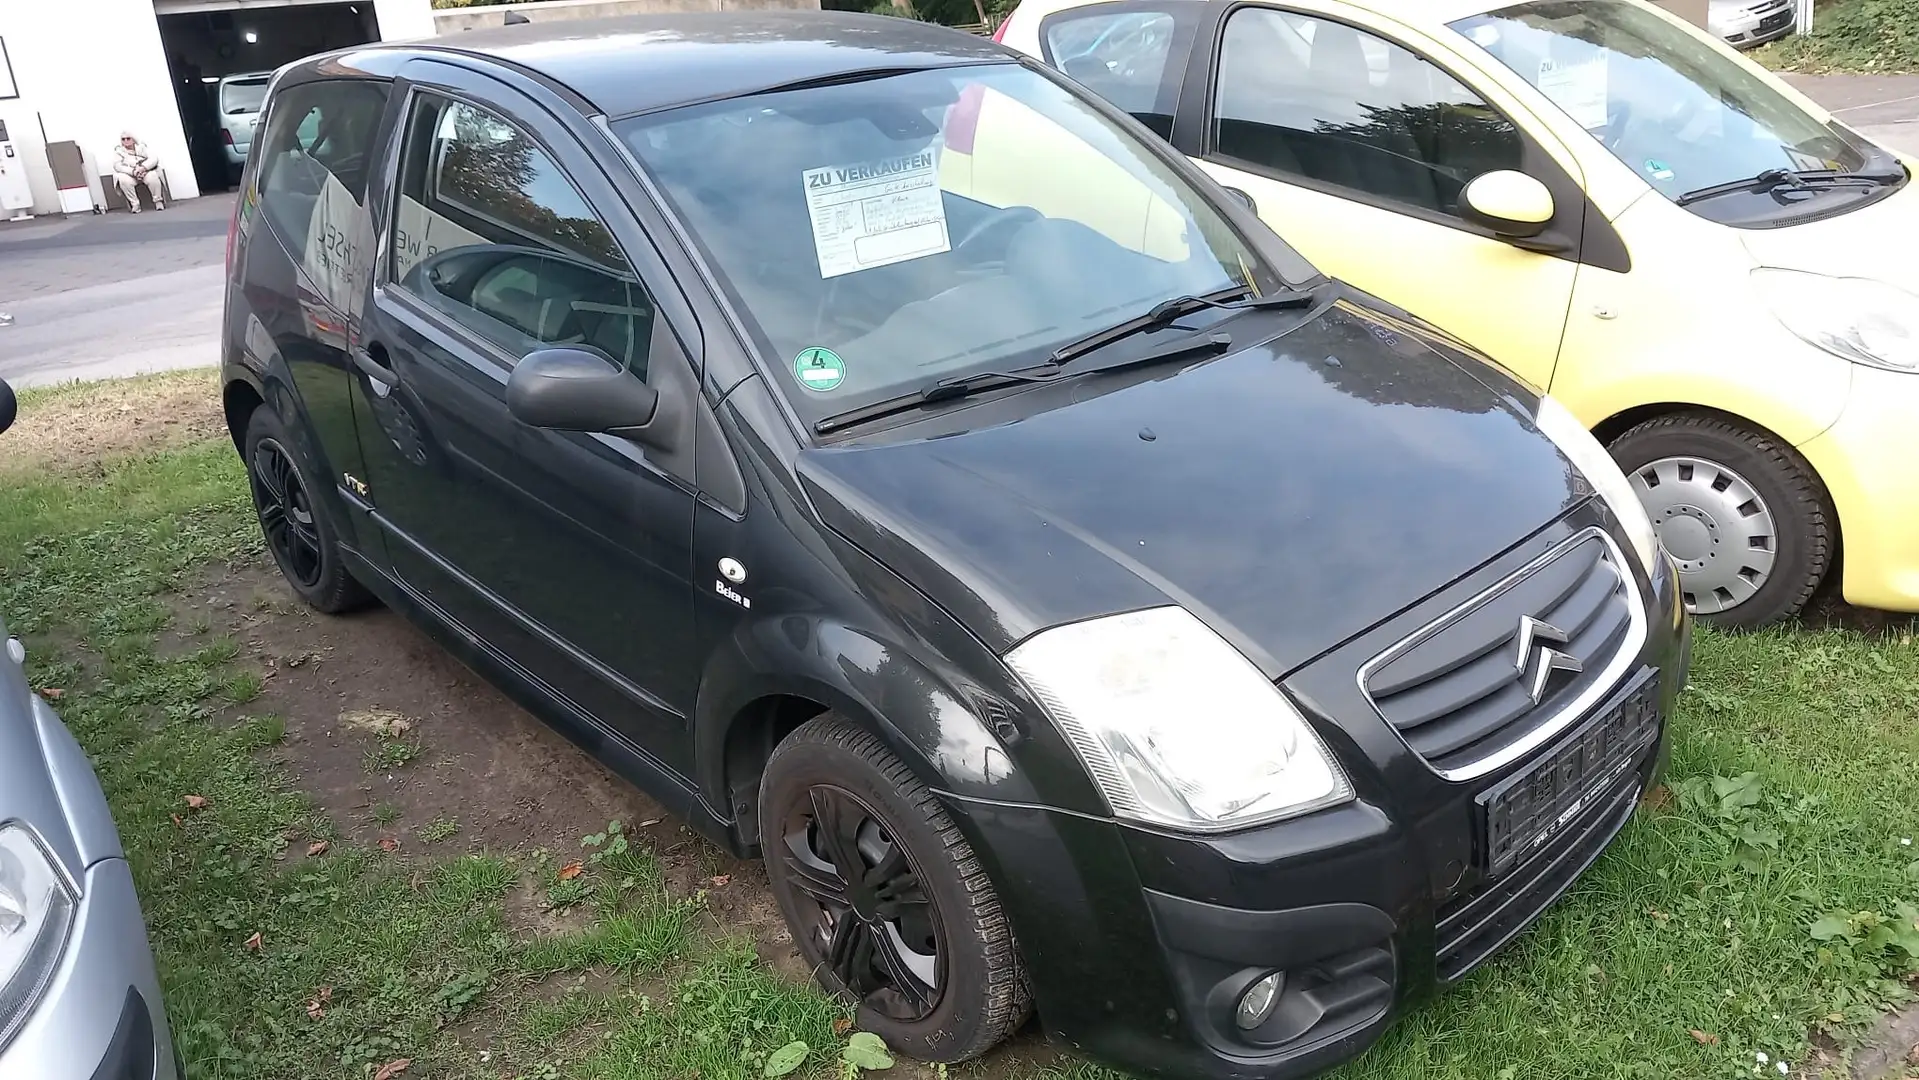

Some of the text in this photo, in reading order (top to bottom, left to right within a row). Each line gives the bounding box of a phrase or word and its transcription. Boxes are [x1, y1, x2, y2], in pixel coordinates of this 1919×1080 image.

[808, 152, 932, 189] ZU VERKAUFEN
[811, 350, 826, 369] 4
